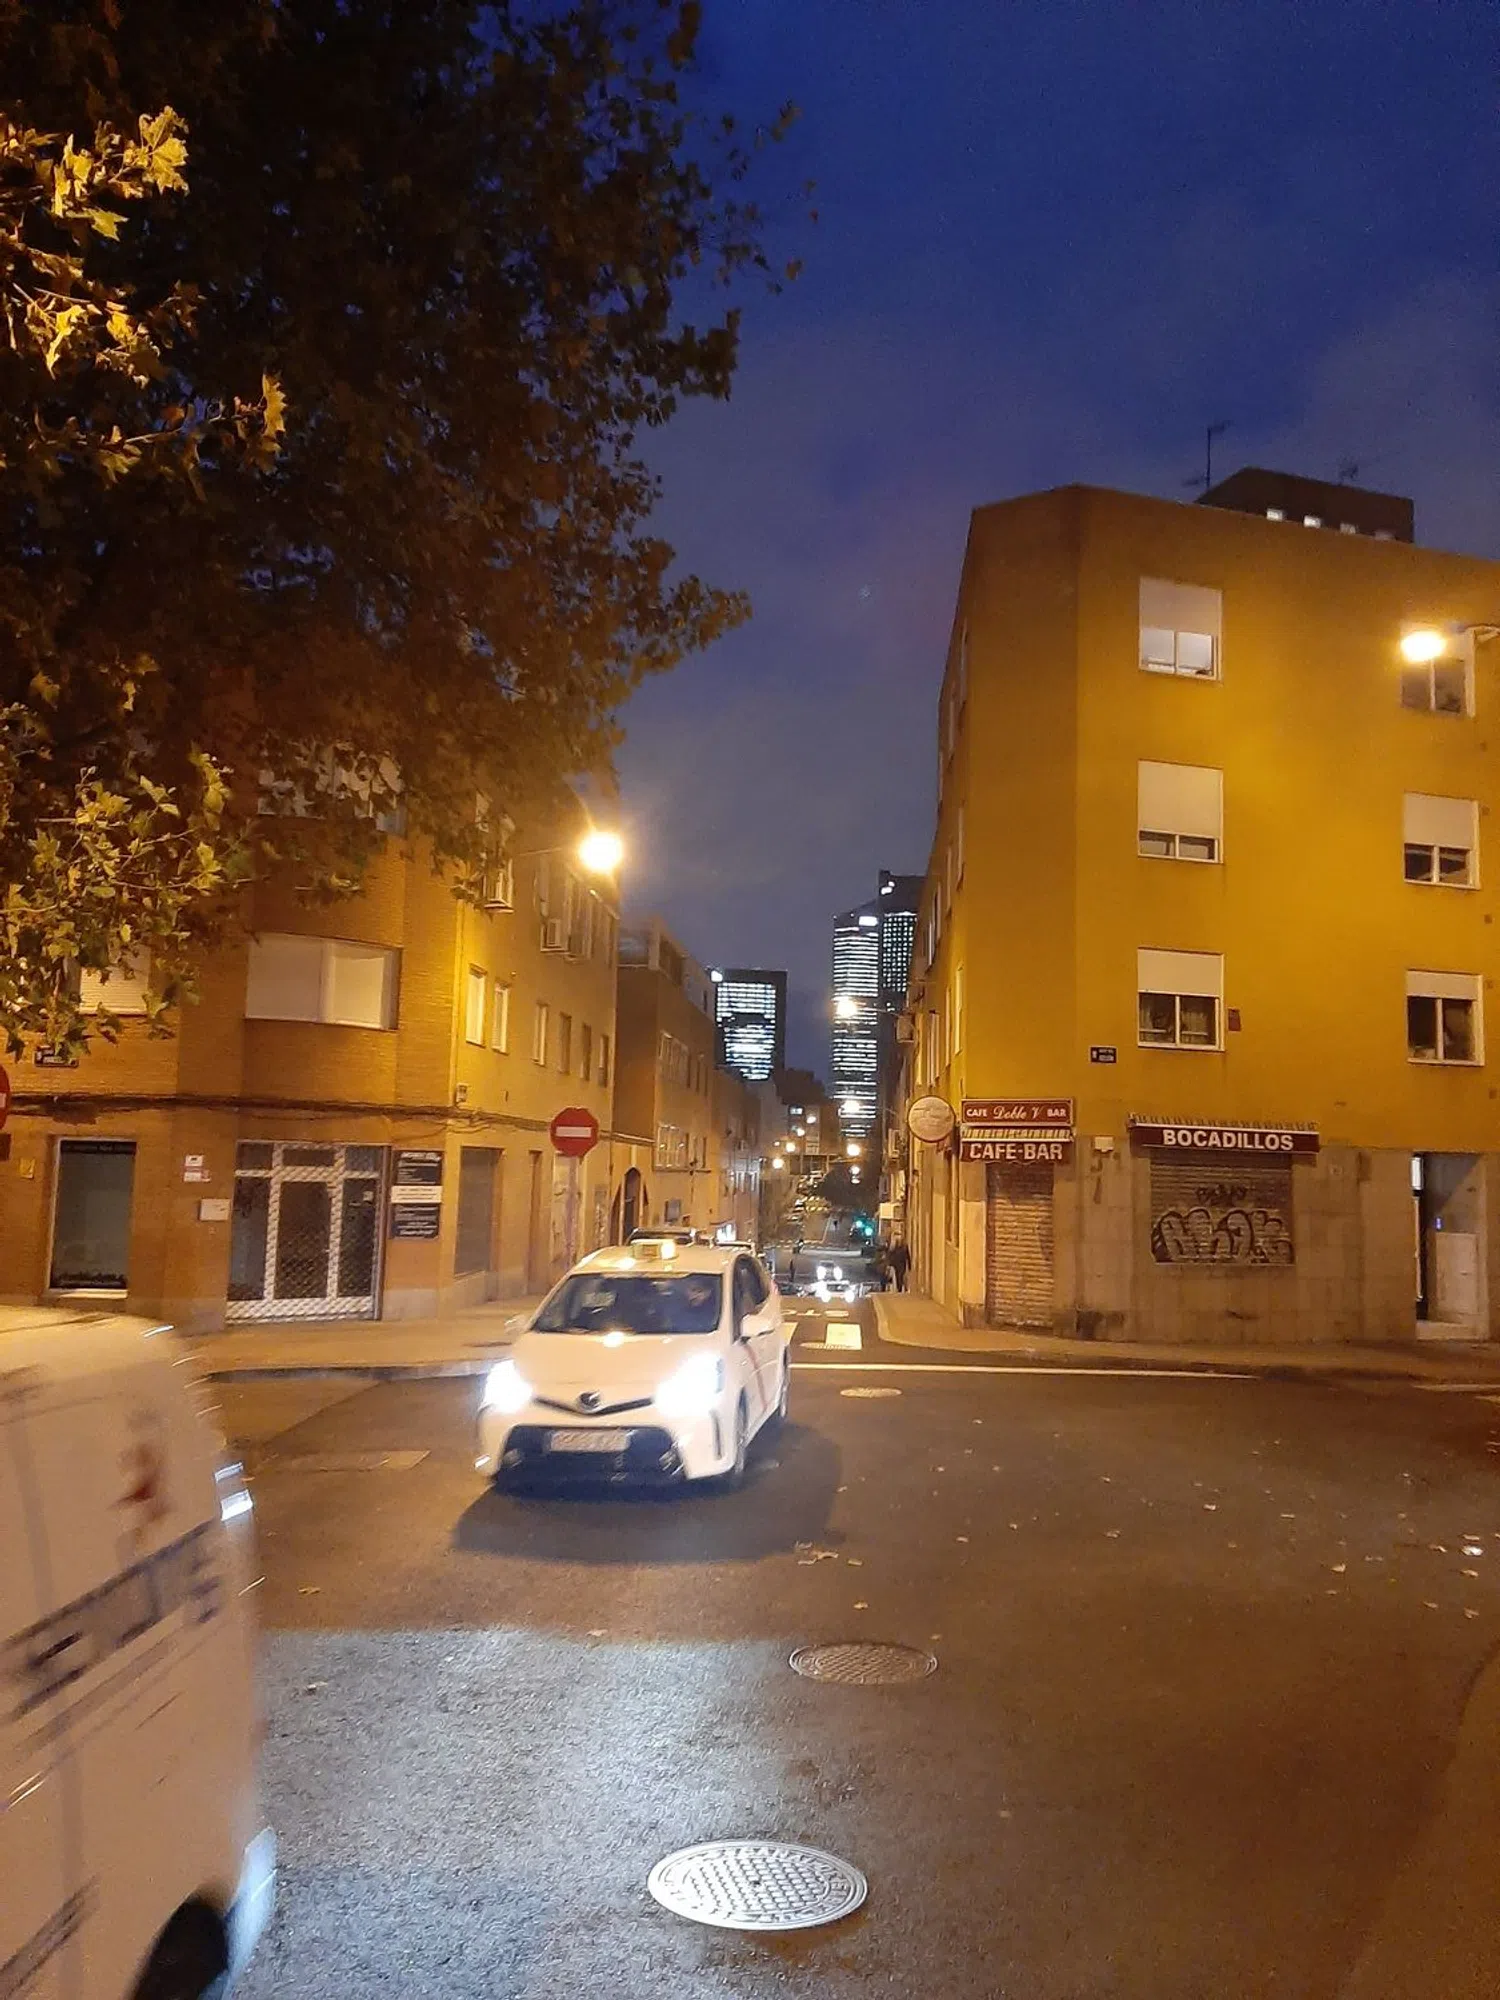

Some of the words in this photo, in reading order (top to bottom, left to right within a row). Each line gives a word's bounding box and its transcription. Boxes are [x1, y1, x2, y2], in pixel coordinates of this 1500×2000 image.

[966, 1108, 988, 1117] CAFE
[1047, 1109, 1067, 1118] BAR
[1162, 1129, 1294, 1150] BOCADILLOS
[969, 1143, 1063, 1160] CAFE-BAR
